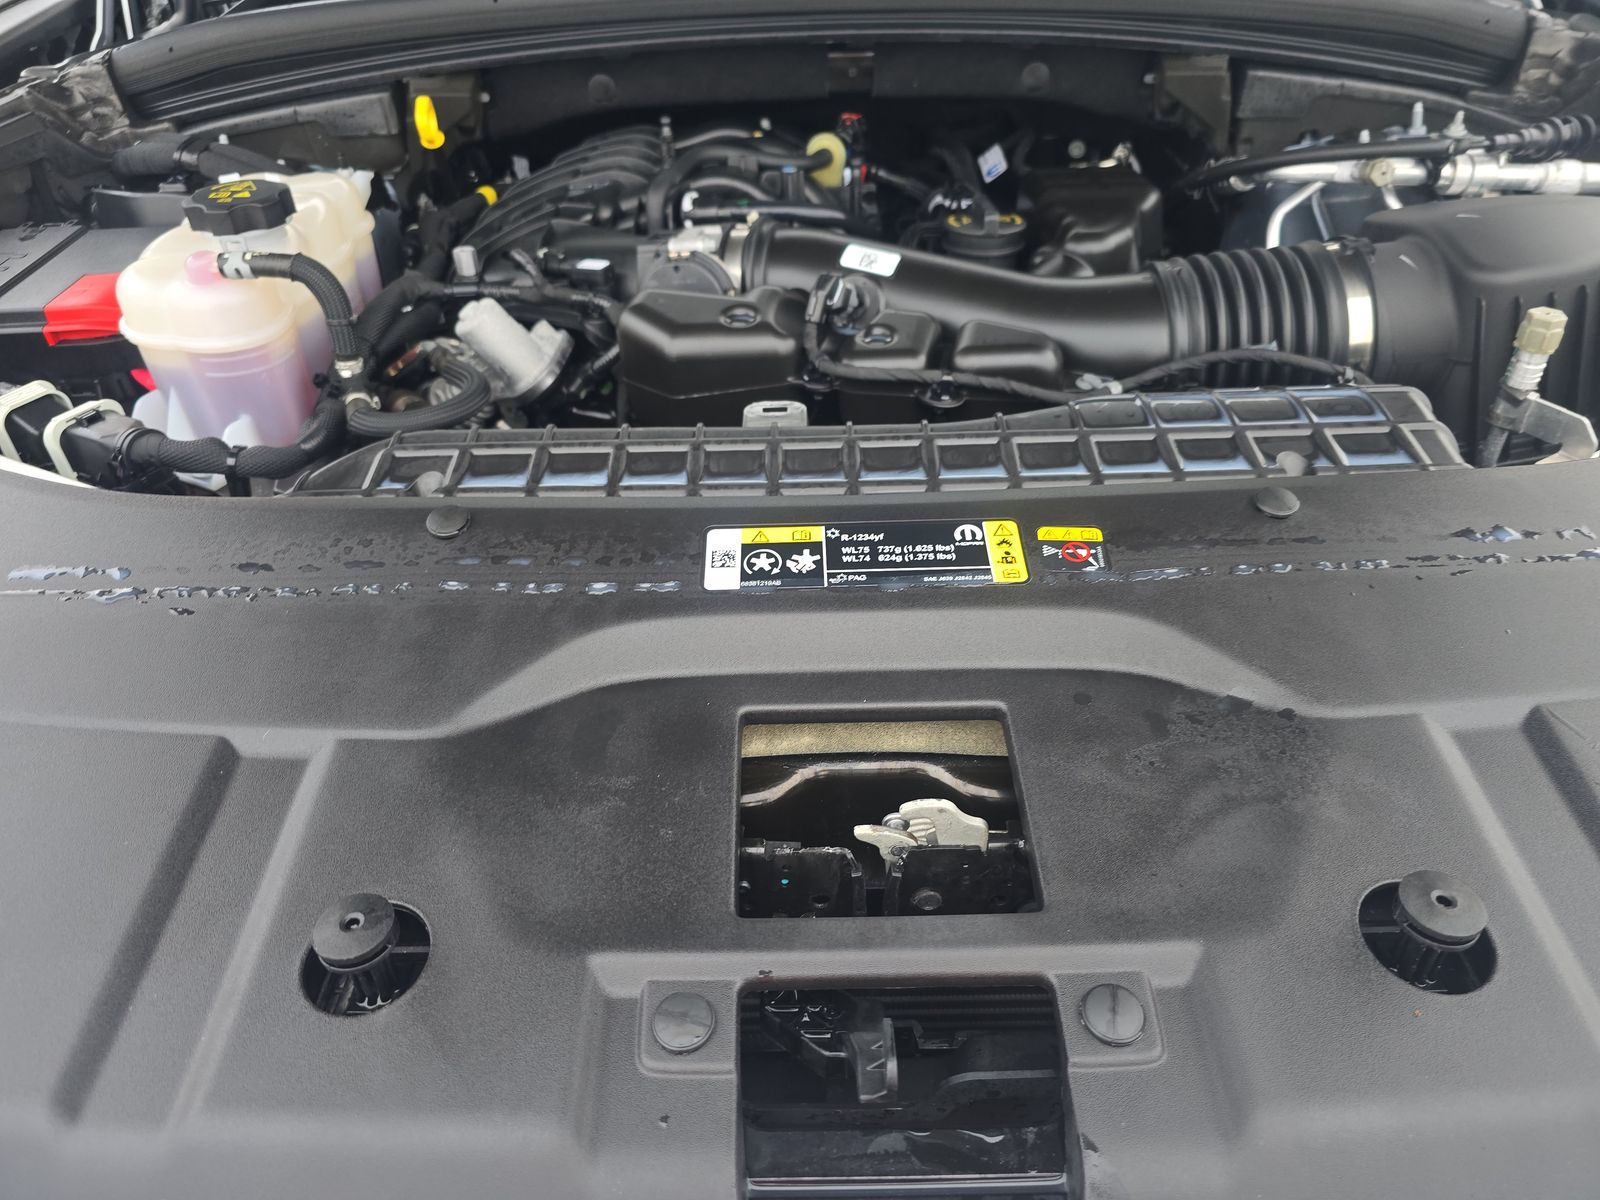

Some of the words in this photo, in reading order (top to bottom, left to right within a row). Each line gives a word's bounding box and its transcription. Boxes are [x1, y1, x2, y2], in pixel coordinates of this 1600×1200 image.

[841, 546, 870, 554] WL75
[877, 545, 902, 554] 737g
[903, 544, 934, 554] (1.625
[935, 543, 955, 553] lbs)
[842, 554, 871, 563] WL74
[878, 554, 903, 563] 624g
[904, 553, 935, 562] (1.375
[936, 552, 957, 562] lbs)
[848, 574, 867, 582] PAG
